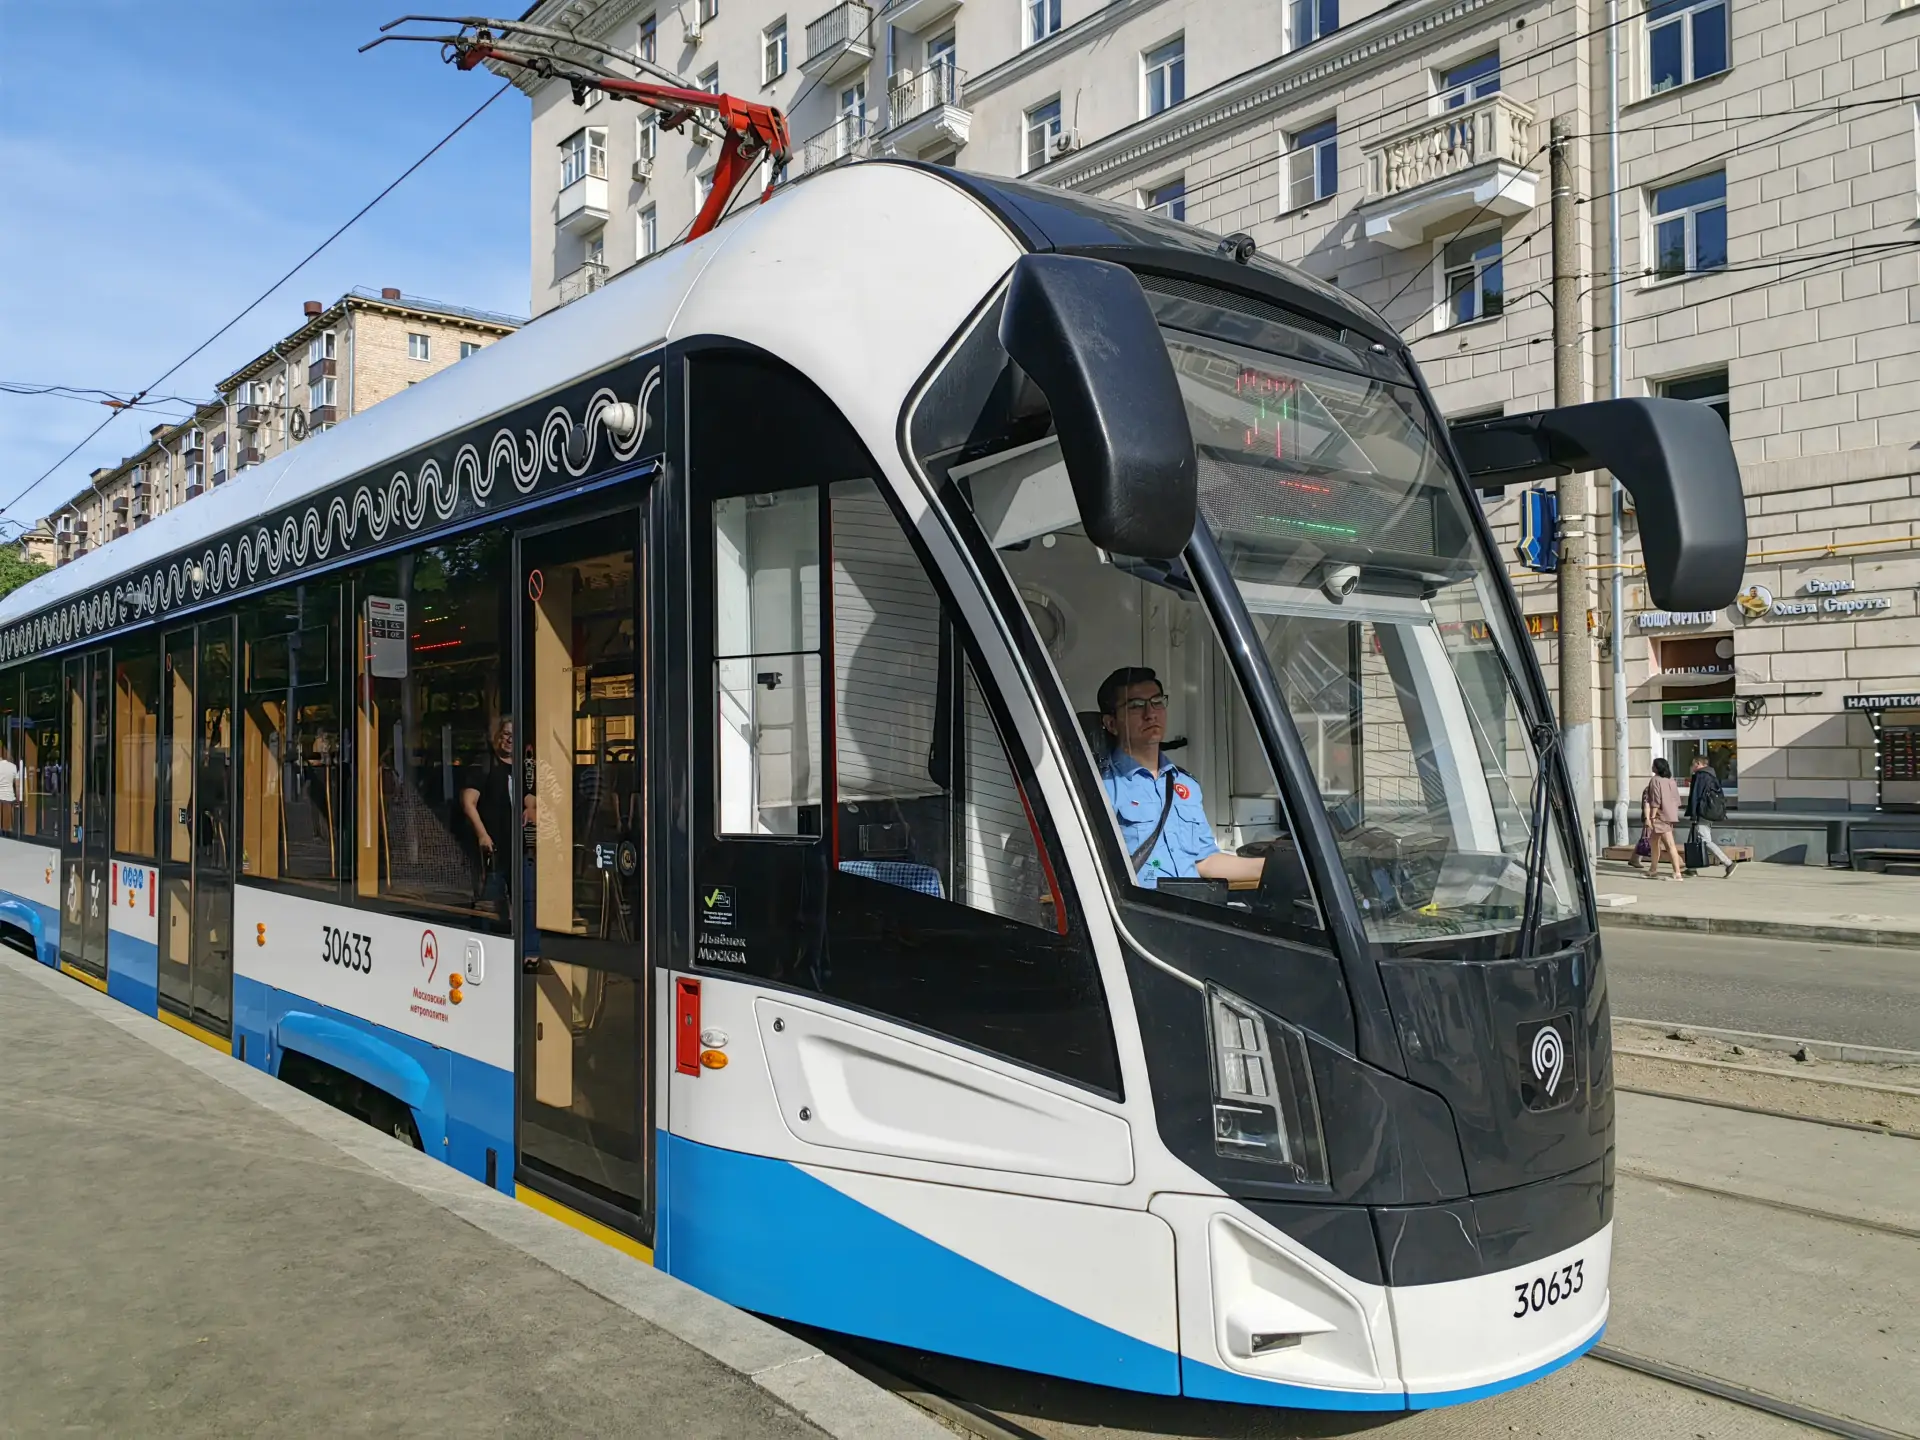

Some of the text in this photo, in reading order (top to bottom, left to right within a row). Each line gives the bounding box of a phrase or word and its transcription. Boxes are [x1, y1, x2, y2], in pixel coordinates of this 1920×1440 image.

[1806, 579, 1855, 595] Сыры
[1773, 597, 1892, 616] Олега Сироты
[1671, 610, 1717, 626] ФРУКТЫ
[1847, 695, 1920, 708] НАПИТКИ
[698, 932, 747, 948] Львёнок
[322, 925, 372, 975] 30633
[412, 986, 447, 1006] Московский
[410, 1004, 449, 1023] метрополитен
[1512, 1258, 1584, 1319] 30633
